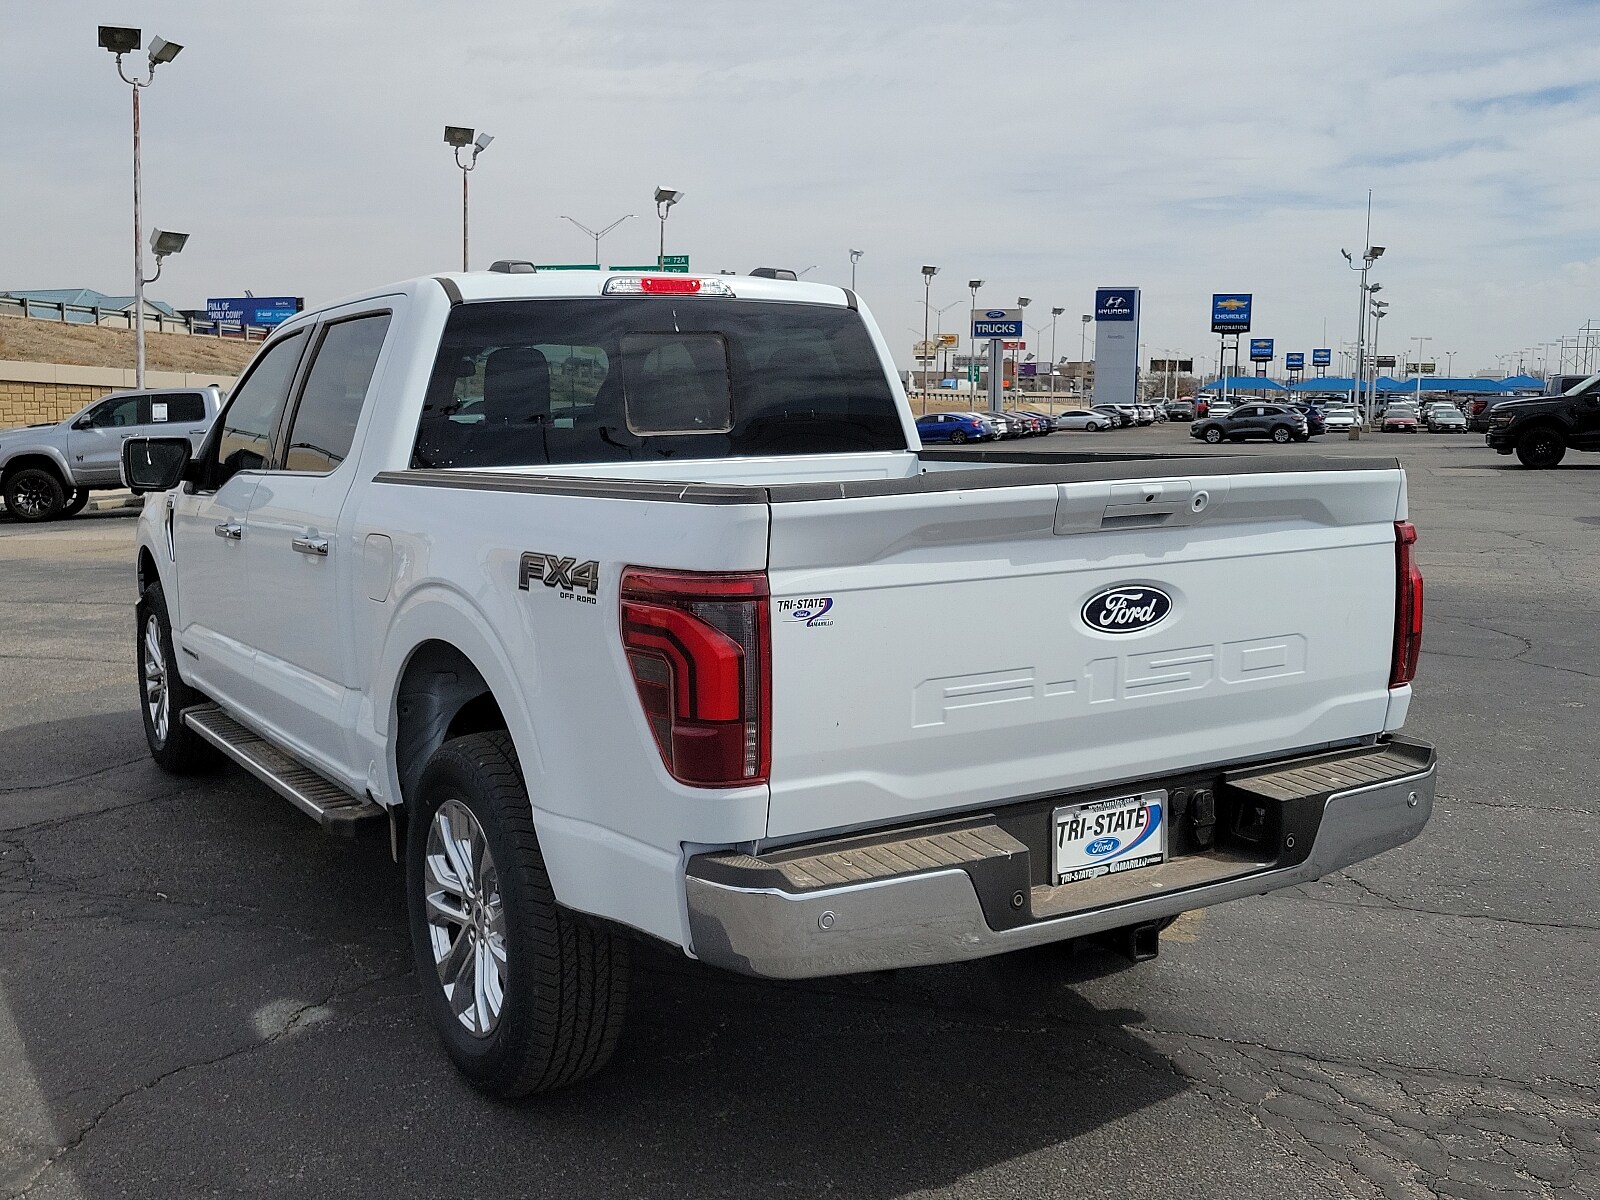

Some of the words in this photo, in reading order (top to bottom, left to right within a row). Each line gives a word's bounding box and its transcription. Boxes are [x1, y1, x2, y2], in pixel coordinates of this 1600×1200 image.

[208, 302, 221, 310] FULL
[221, 302, 230, 310] OF
[976, 324, 1016, 333] TRUCKS
[518, 551, 600, 594] FX4
[560, 592, 575, 601] OFF
[576, 595, 597, 604] ROAD
[777, 598, 825, 613] TRI-STATE
[1096, 590, 1160, 628] Ford
[911, 633, 1308, 729] F-150
[1057, 806, 1147, 849] TRI-STATE
[1090, 839, 1115, 855] Ford
[1061, 868, 1094, 885] TRI-STATE
